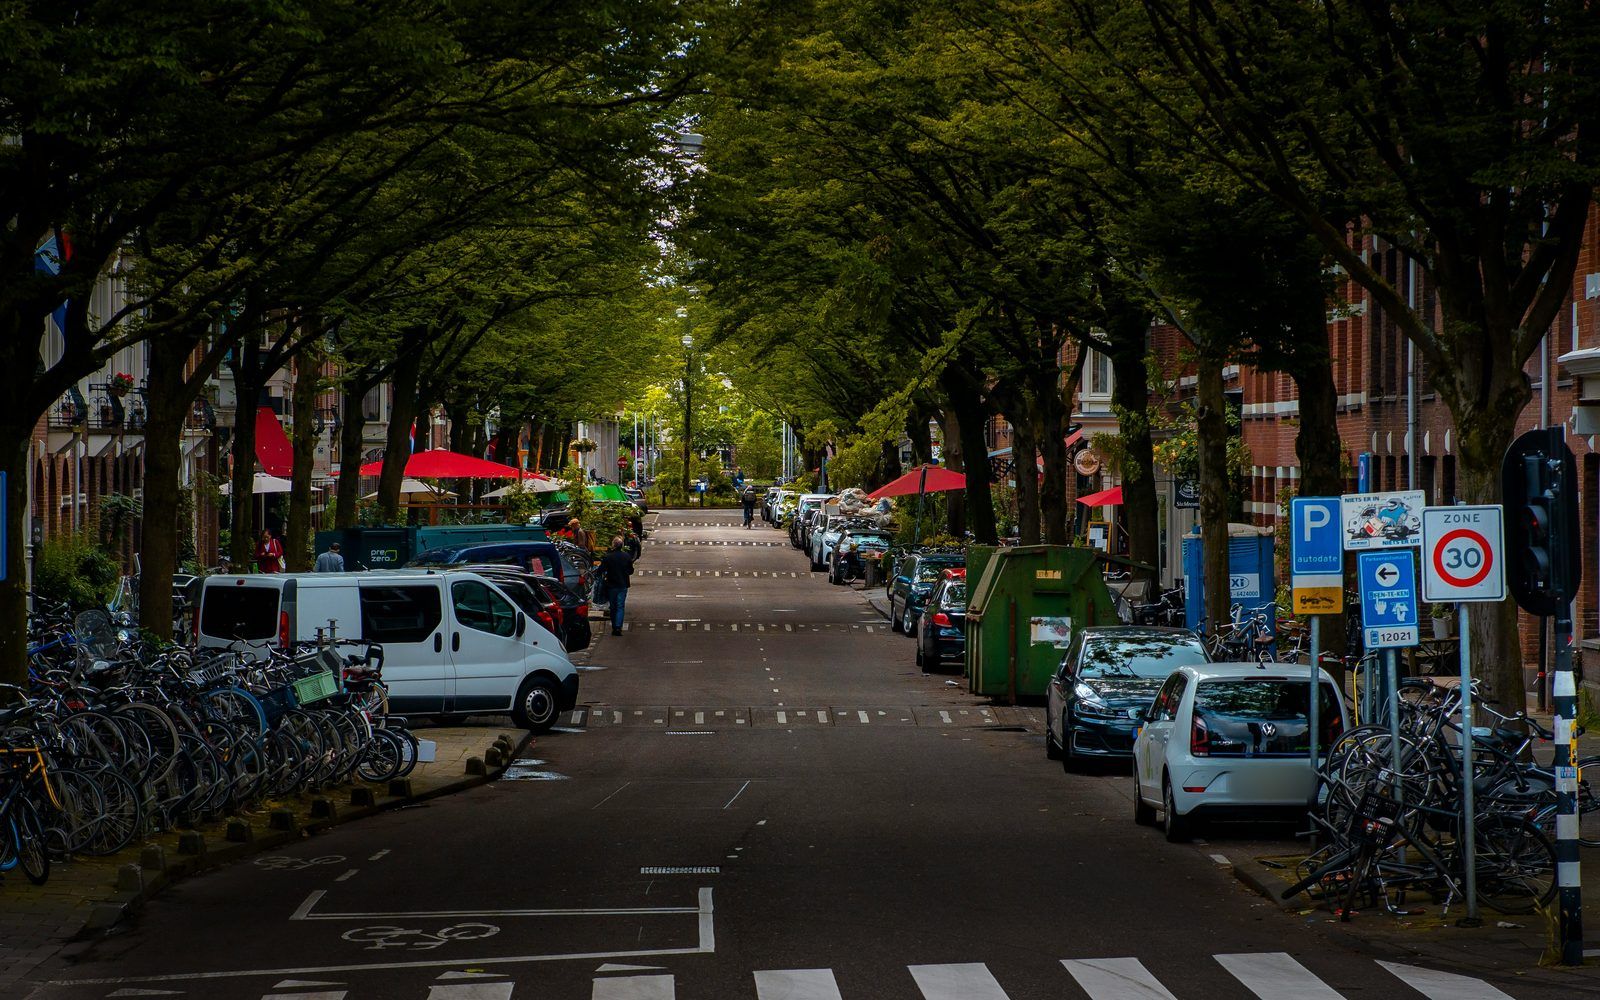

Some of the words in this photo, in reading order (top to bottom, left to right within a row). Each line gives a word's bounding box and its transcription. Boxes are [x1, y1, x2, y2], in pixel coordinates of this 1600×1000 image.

[1303, 504, 1331, 542] P
[1443, 513, 1481, 523] ZONE
[1297, 555, 1338, 563] autodate
[1446, 547, 1482, 569] 30
[1381, 632, 1411, 642] 12021
